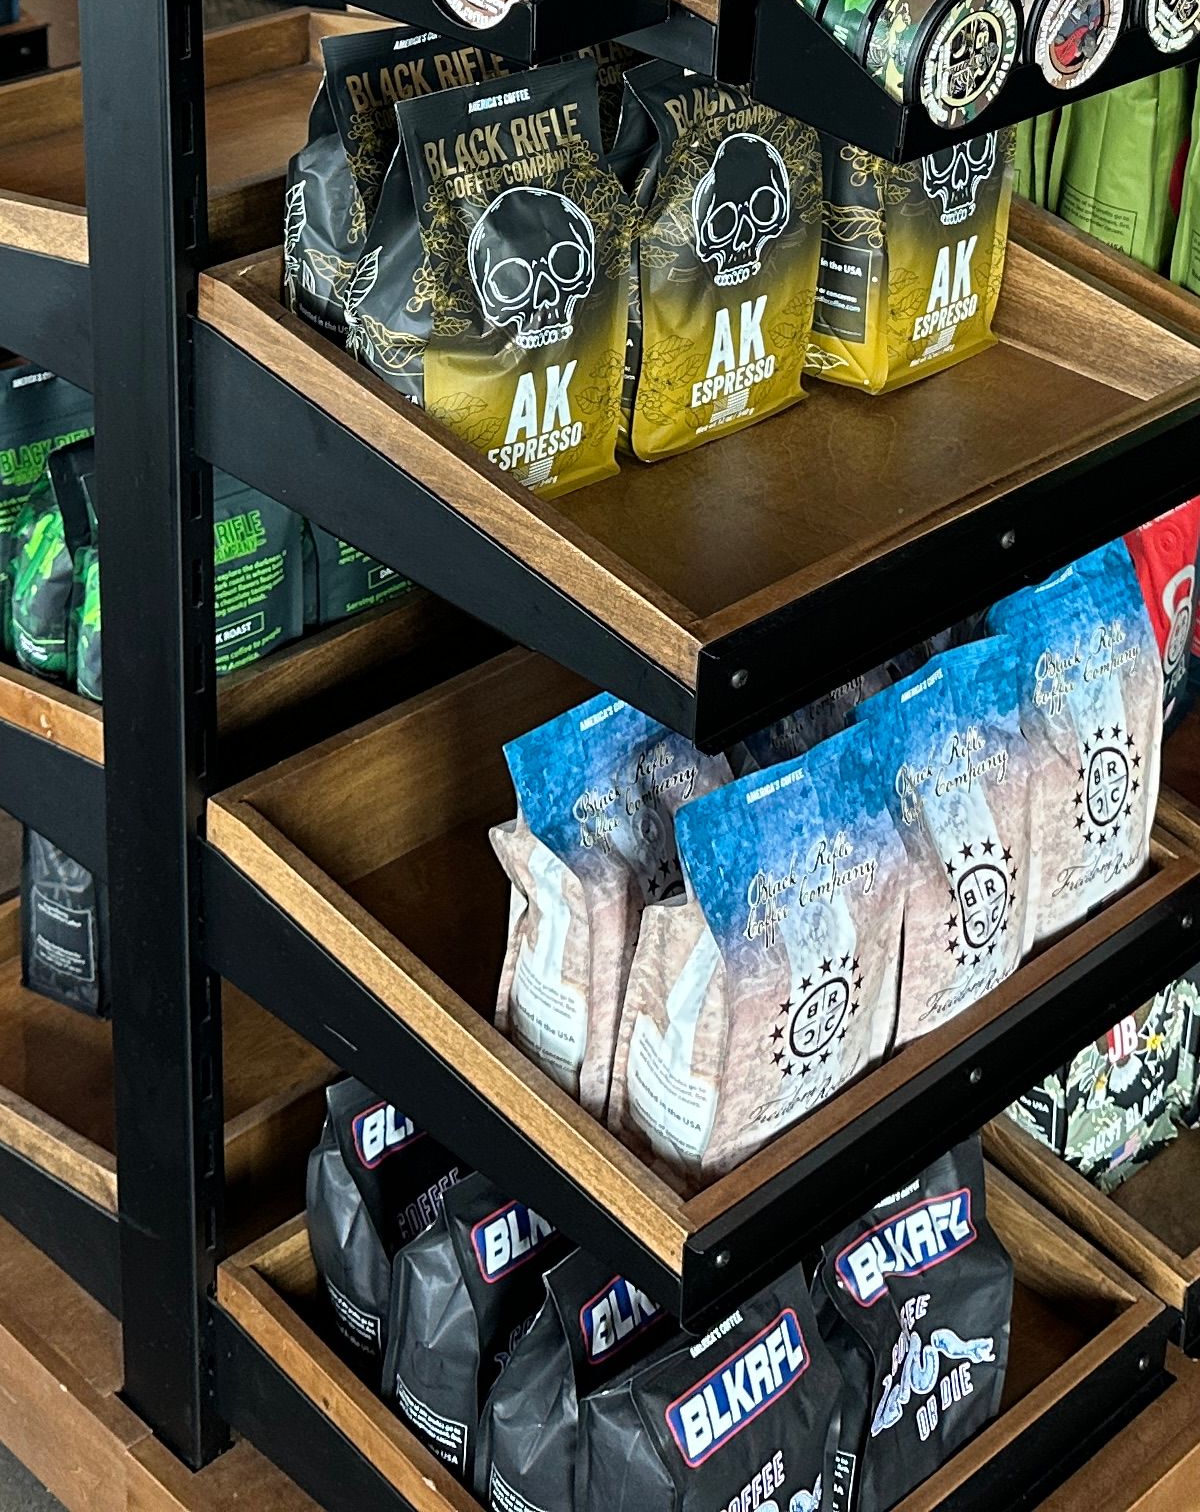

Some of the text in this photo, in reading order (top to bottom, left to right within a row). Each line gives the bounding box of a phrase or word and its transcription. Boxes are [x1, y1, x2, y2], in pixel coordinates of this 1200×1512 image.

[346, 59, 431, 113] BLACK
[468, 89, 530, 114] AMERICA'S COFFEE
[424, 103, 582, 182] BLACK RIFLE
[446, 147, 572, 200] COFFEE COMPANY
[829, 260, 843, 272] the
[843, 264, 863, 277] USA
[926, 235, 978, 313] AK
[705, 294, 768, 378] AK
[912, 294, 978, 342] ESPRESSO
[504, 359, 578, 445] AK
[690, 355, 776, 409] ESPRESSO
[488, 421, 584, 471] ESPRESSO
[215, 510, 266, 546] RIFLE
[224, 621, 252, 638] ROAST
[1034, 619, 1127, 681] Black Rifle
[1032, 645, 1141, 718] Coffee Company
[944, 726, 986, 764] Rifle
[572, 742, 675, 823] Black Rifle
[624, 765, 699, 817] Company
[745, 767, 805, 805] AMERICA'S COFFEE
[935, 748, 1009, 799] Company
[746, 831, 854, 909] Black Rifle
[743, 854, 878, 949] Coffee Company
[557, 1030, 575, 1043] USA
[1108, 1014, 1139, 1065] JB
[682, 1116, 702, 1132] USA
[1126, 1080, 1165, 1133] BLACK
[846, 1196, 972, 1301] BLKRFL
[719, 1310, 744, 1336] COFFEE
[679, 1320, 805, 1459] BLKRFL
[941, 1362, 975, 1411] DIE
[720, 1449, 786, 1512] FFEE
